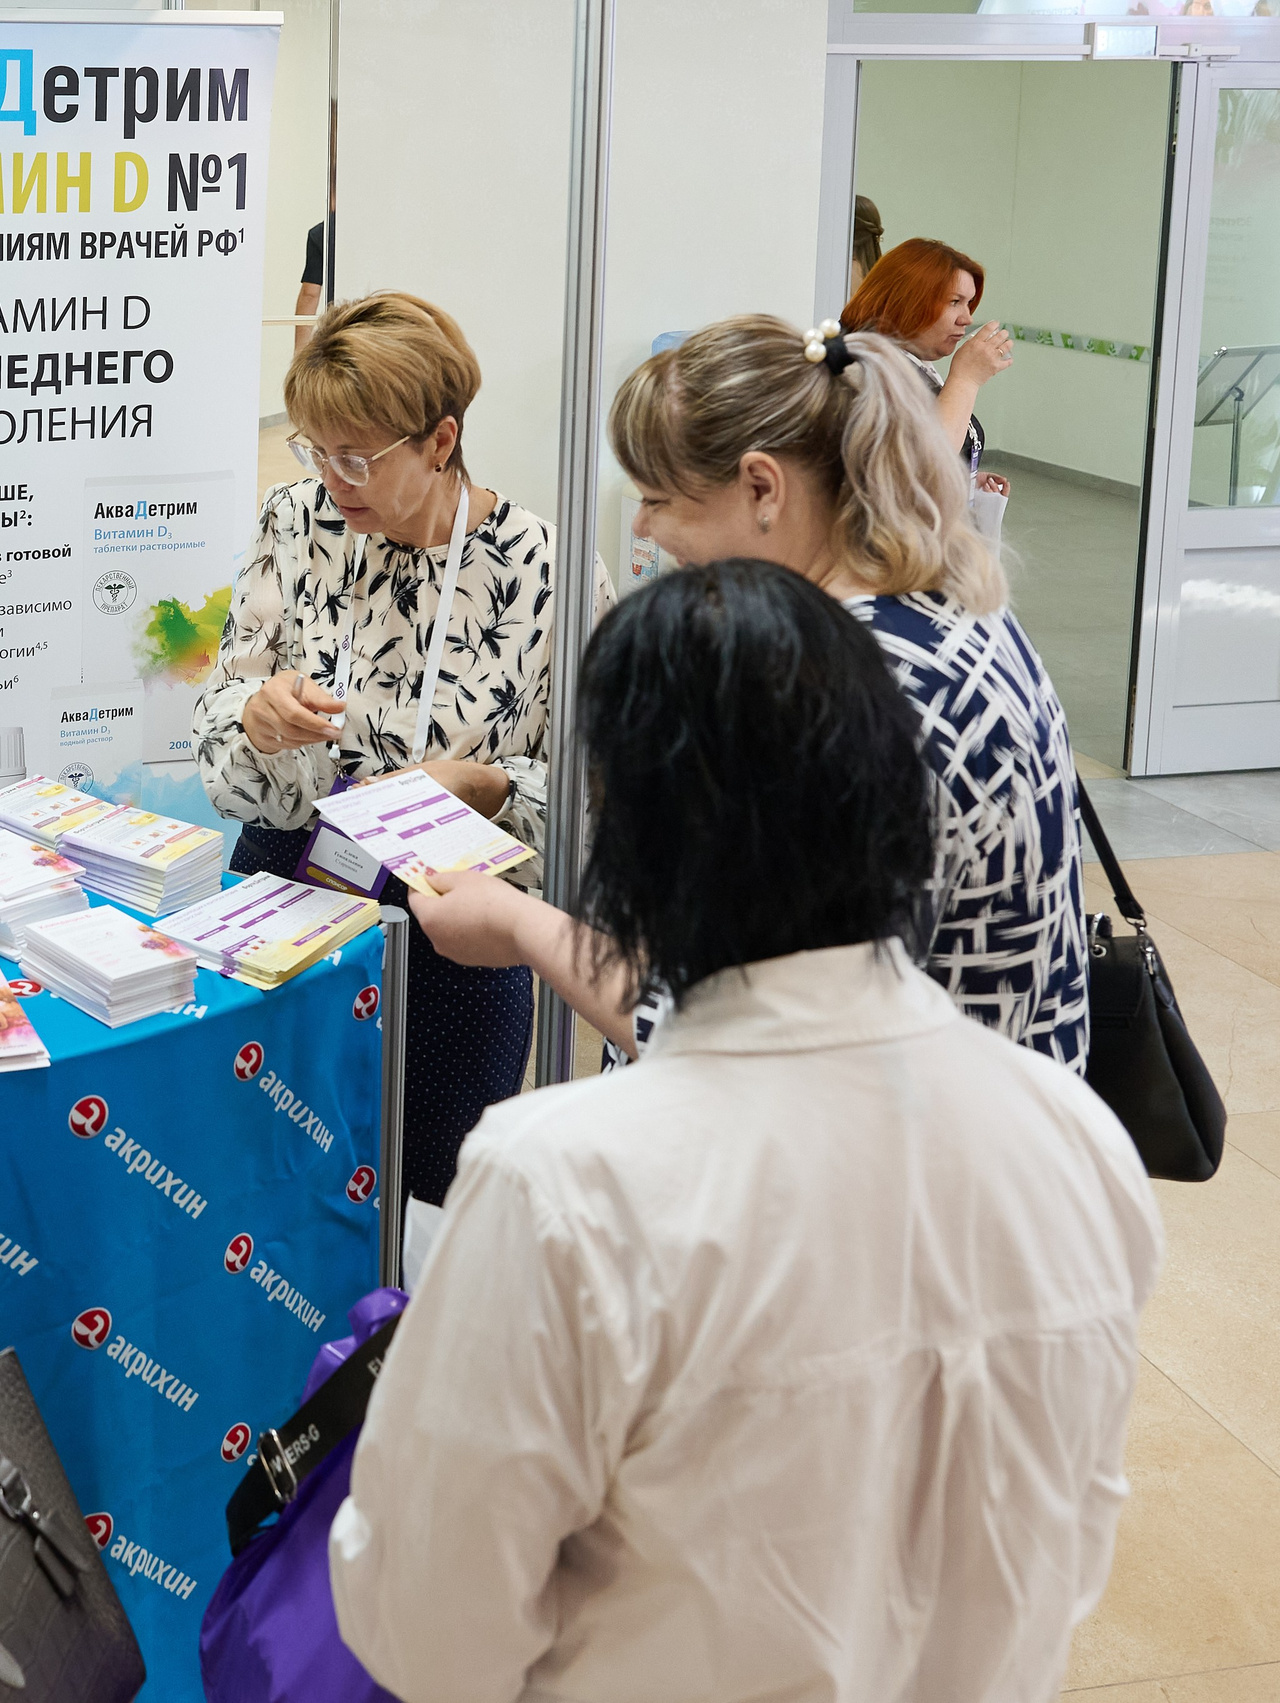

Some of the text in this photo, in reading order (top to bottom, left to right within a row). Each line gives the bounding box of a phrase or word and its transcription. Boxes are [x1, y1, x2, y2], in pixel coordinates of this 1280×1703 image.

[113, 151, 149, 213] D
[167, 152, 248, 212] №1
[80, 223, 188, 260] ВРАЧЕЙ
[123, 295, 151, 330] D
[93, 500, 198, 520] АкваДетрим
[93, 540, 206, 554] таблетки растворимые
[94, 528, 154, 541] Витамин
[6, 543, 72, 562] готовой
[60, 706, 134, 724] АкваДетрим
[59, 736, 114, 748] водный раствор
[60, 728, 99, 739] Витамин
[259, 1069, 335, 1154] акрихин
[104, 1127, 208, 1220] акрихин
[250, 1258, 326, 1333] акрихин
[107, 1334, 200, 1412] акрихин
[110, 1533, 198, 1601] акрихин
